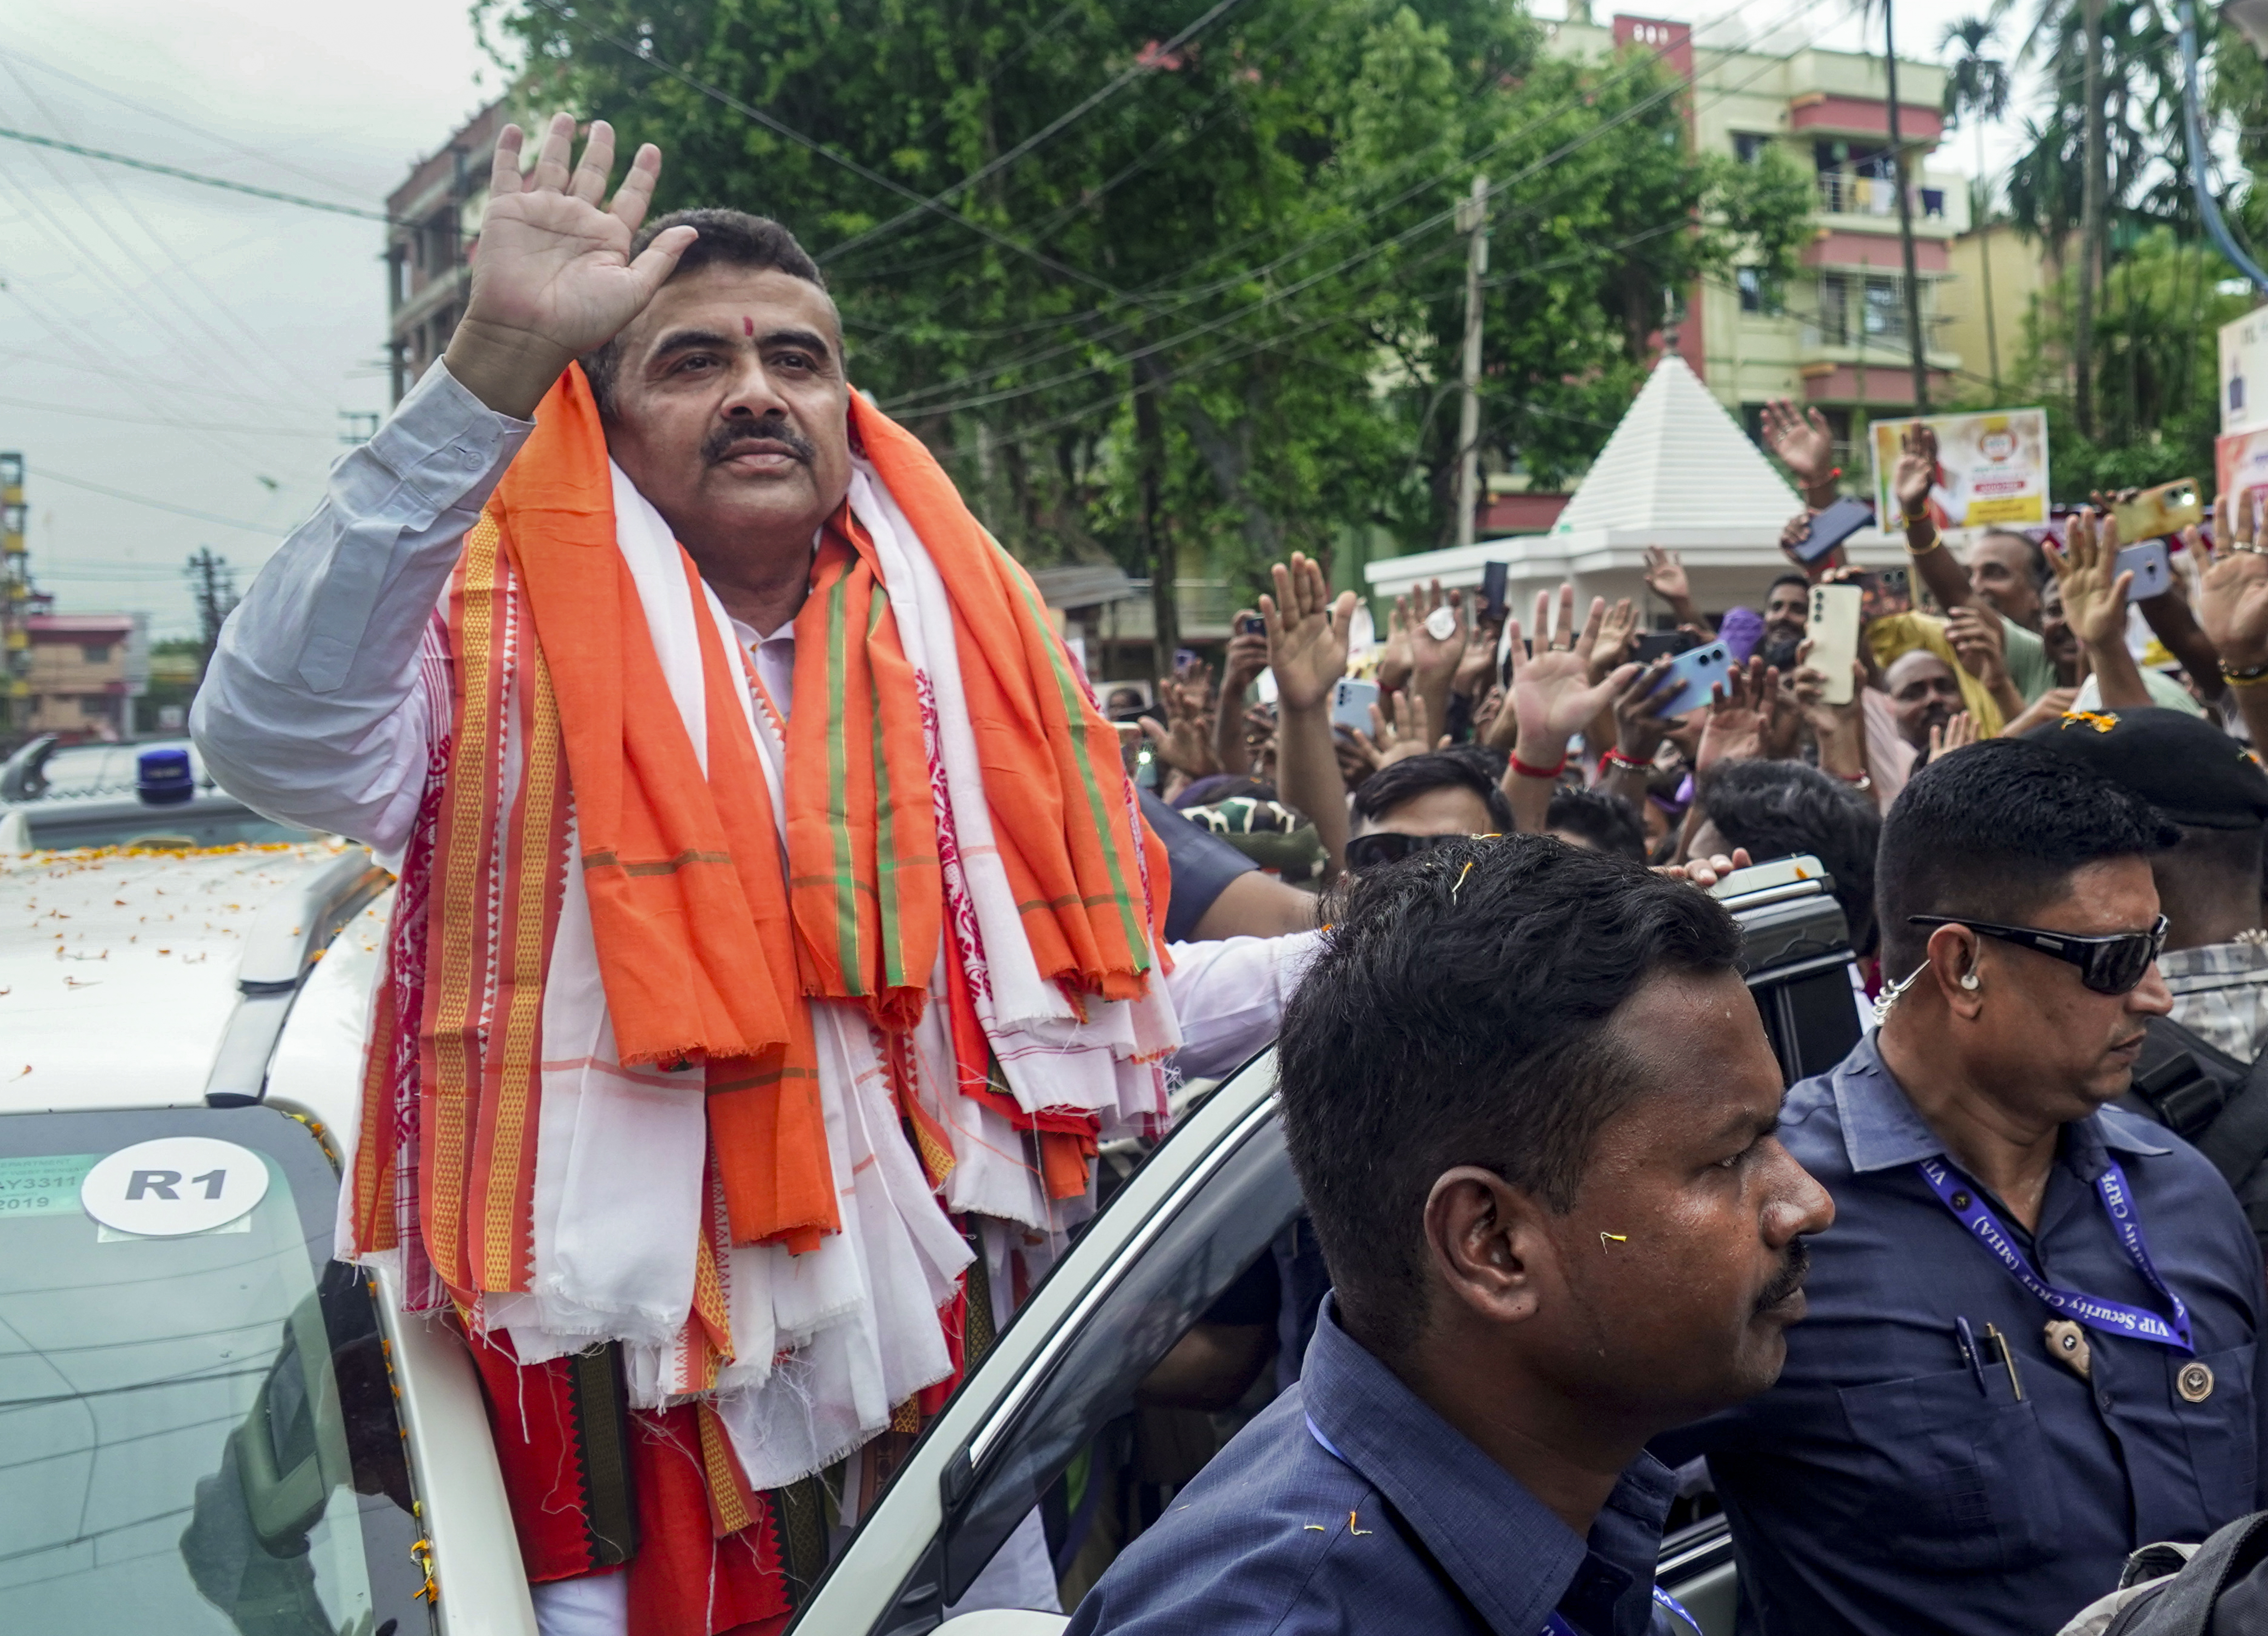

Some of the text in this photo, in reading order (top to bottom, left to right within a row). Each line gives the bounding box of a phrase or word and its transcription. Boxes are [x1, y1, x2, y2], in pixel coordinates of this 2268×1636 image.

[125, 1170, 226, 1200] R1
[0, 1197, 49, 1210] 2019
[1972, 1216, 2019, 1270] (MHA)
[2068, 1296, 2137, 1330] Security
[2138, 1316, 2169, 1337] VIP
